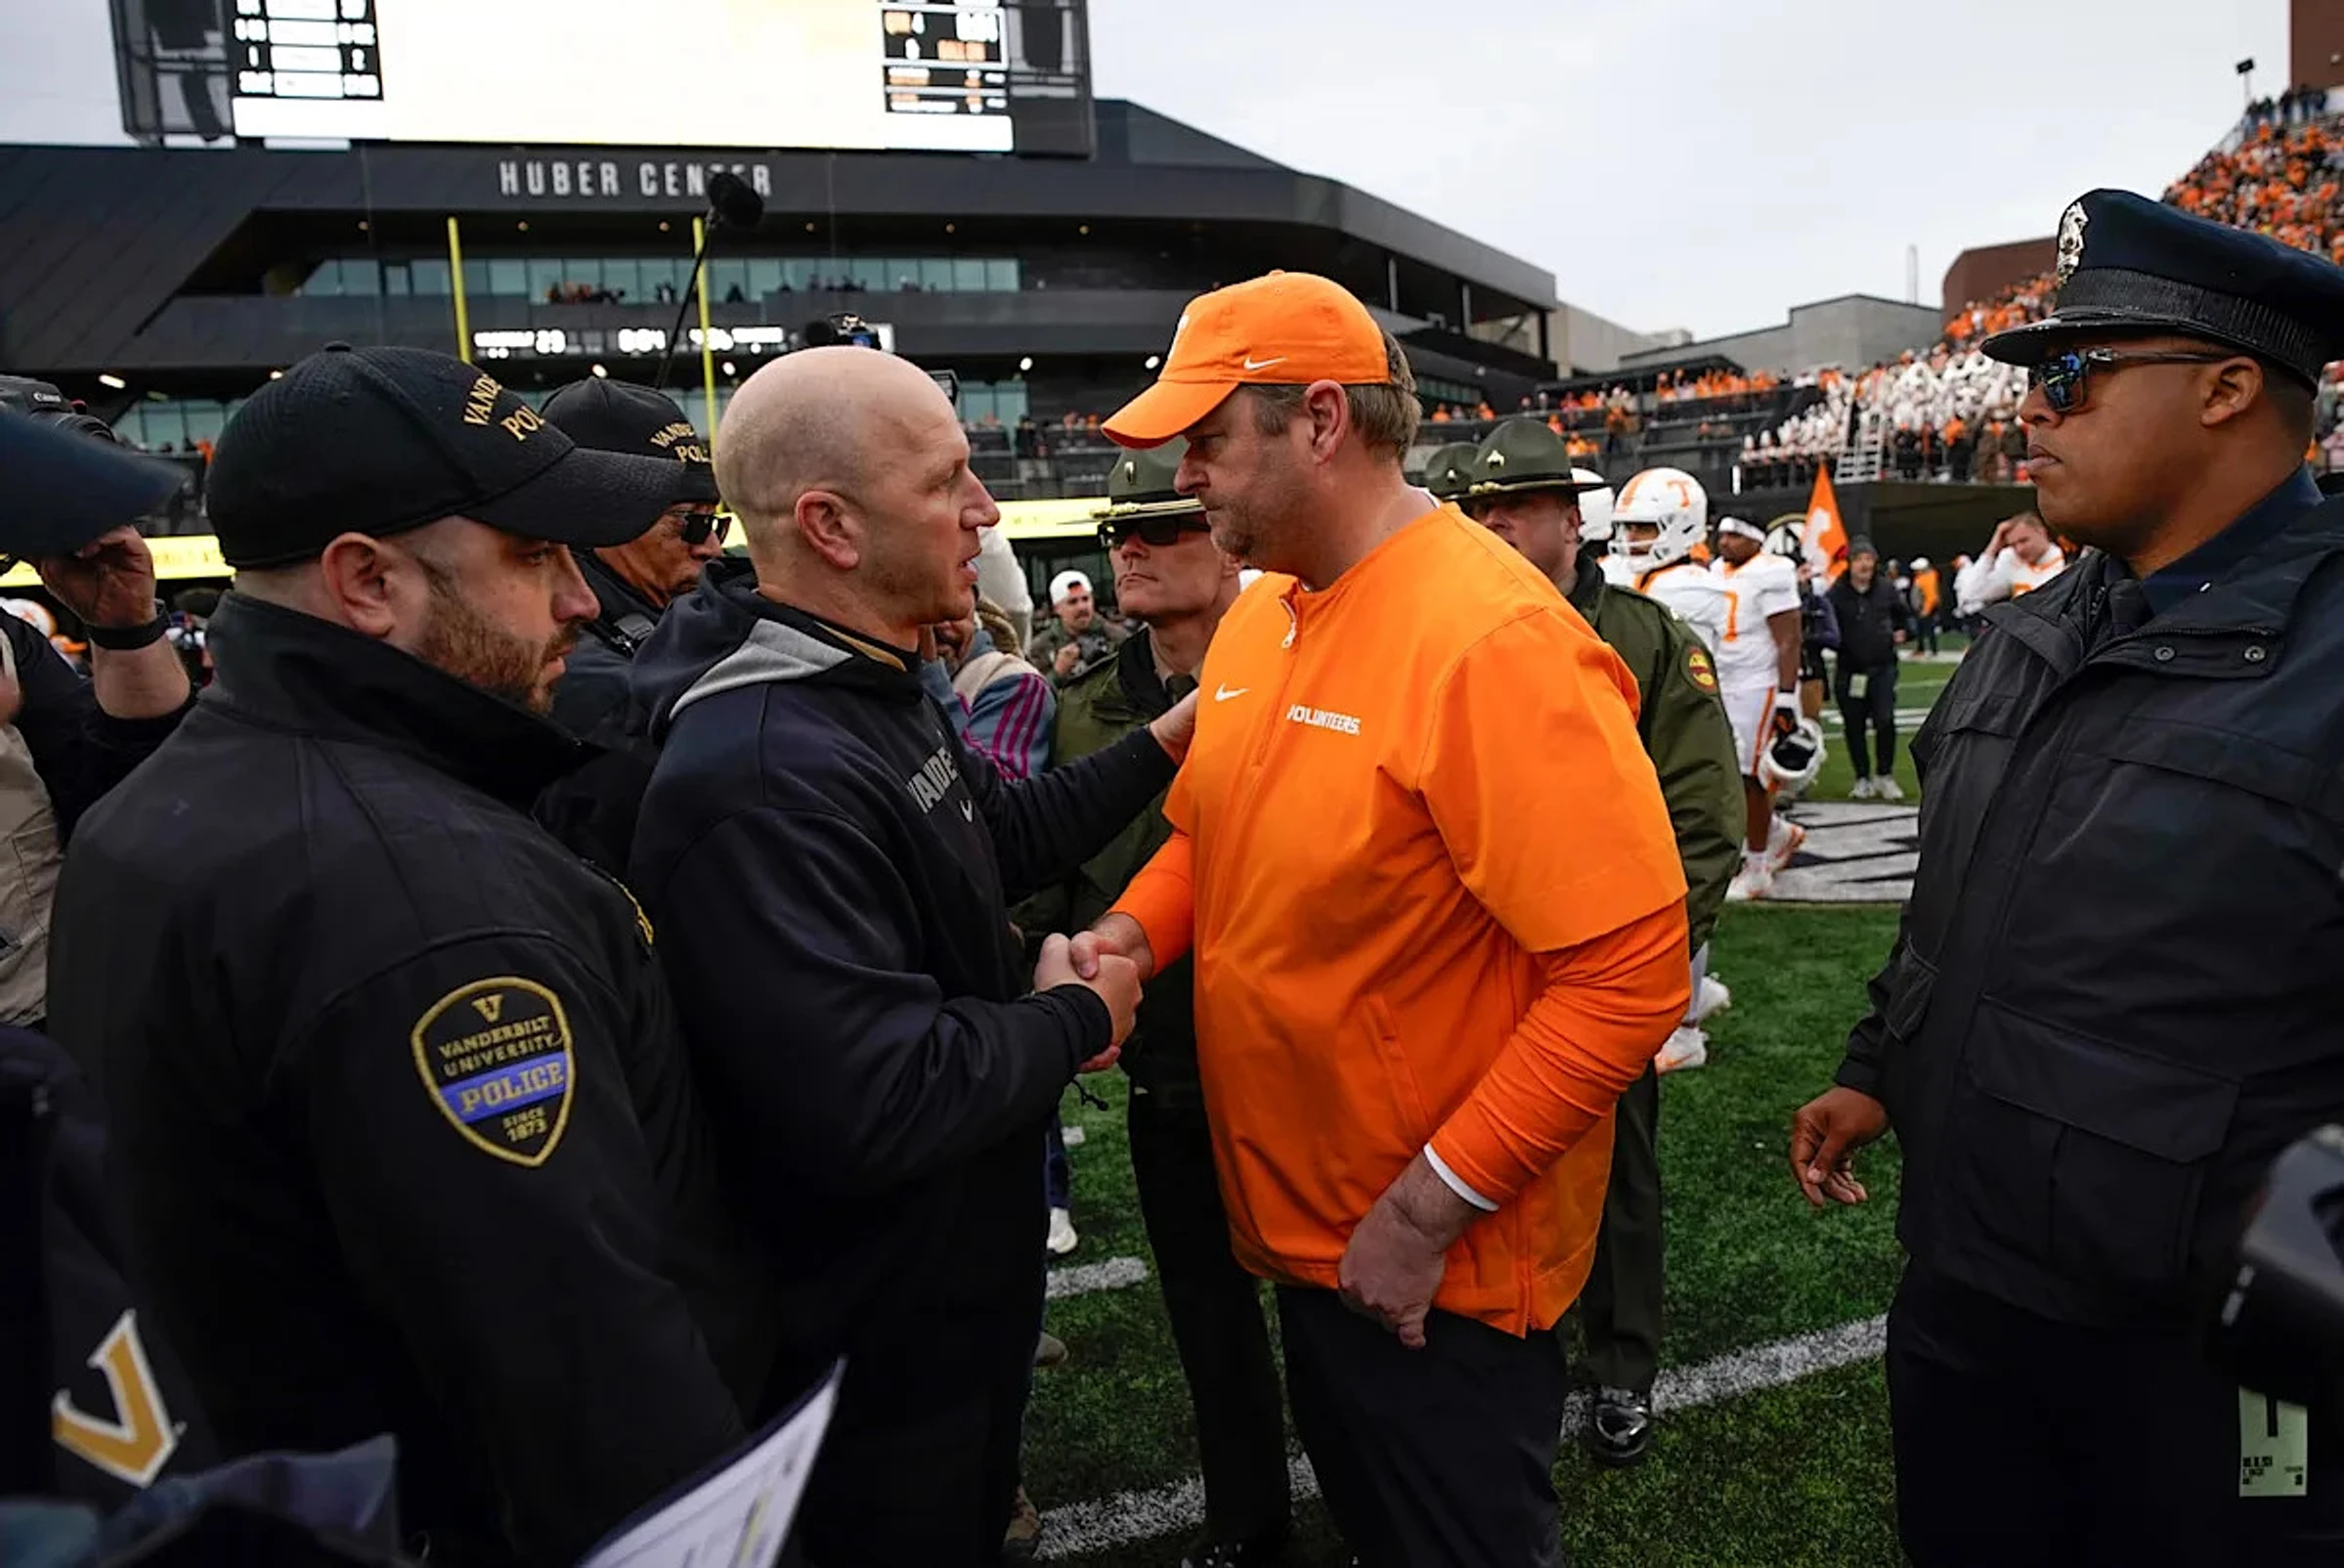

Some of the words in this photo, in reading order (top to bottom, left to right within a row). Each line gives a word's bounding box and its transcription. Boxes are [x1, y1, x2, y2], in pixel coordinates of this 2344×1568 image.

[499, 160, 620, 196] HUBER
[638, 161, 771, 197] CENR
[471, 993, 504, 1024] V
[438, 1016, 550, 1059] VANDERBILT
[443, 1032, 555, 1077] UNIVERSITY
[458, 1061, 564, 1113] POLICE
[52, 1308, 176, 1488] V
